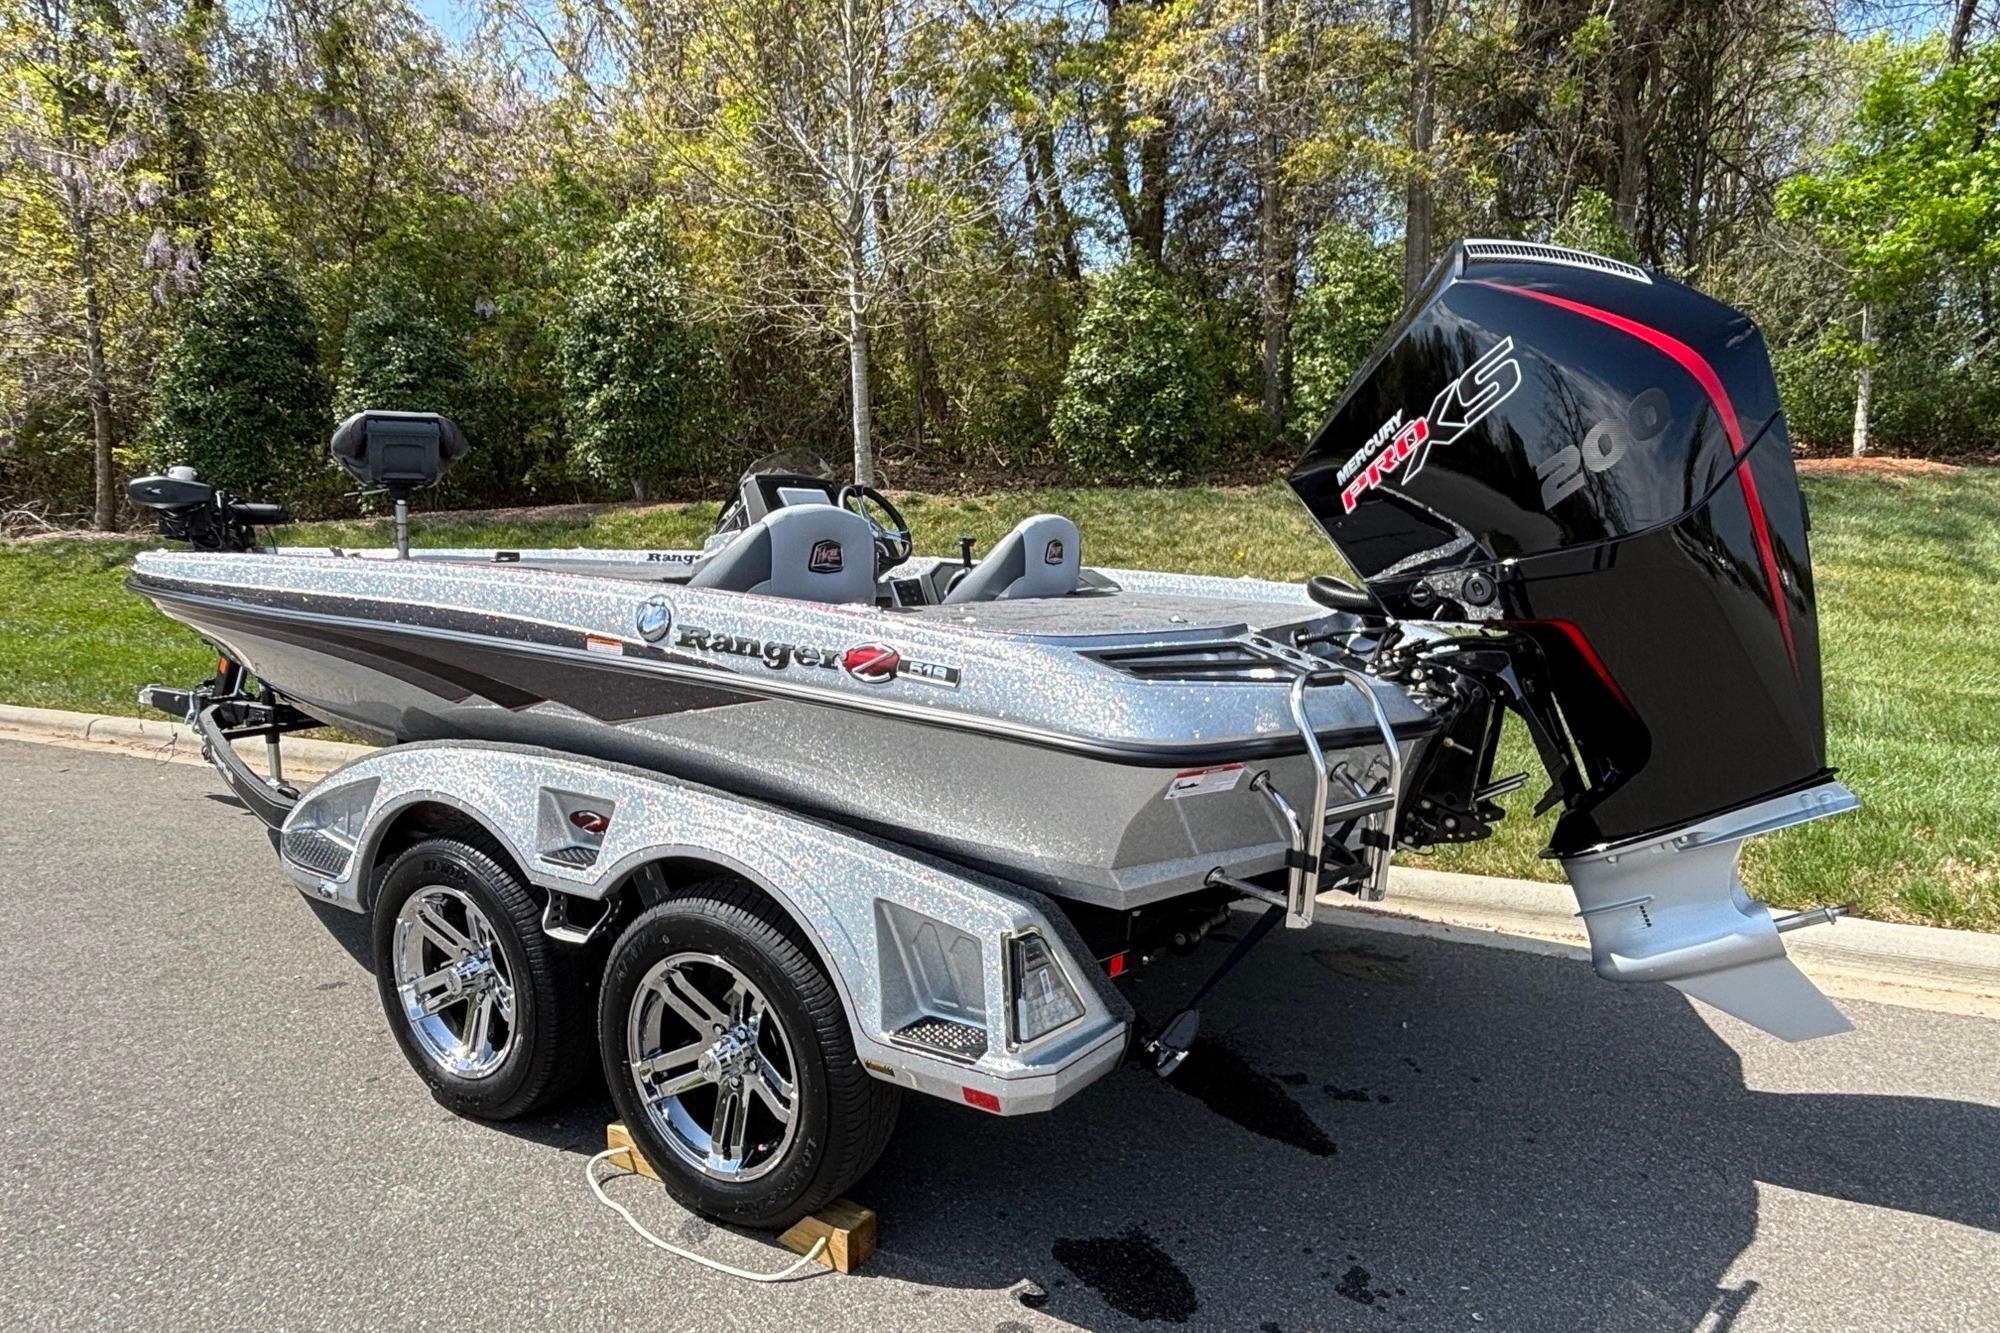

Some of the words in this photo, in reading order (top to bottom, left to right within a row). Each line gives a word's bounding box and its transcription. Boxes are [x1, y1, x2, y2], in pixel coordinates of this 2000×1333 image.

[1336, 408, 1403, 487] MERCURY
[1341, 416, 1429, 515] PRO
[1401, 335, 1522, 486] XS
[1538, 387, 1672, 511] 200
[646, 553, 704, 566] Rang
[675, 623, 846, 671] Ranger
